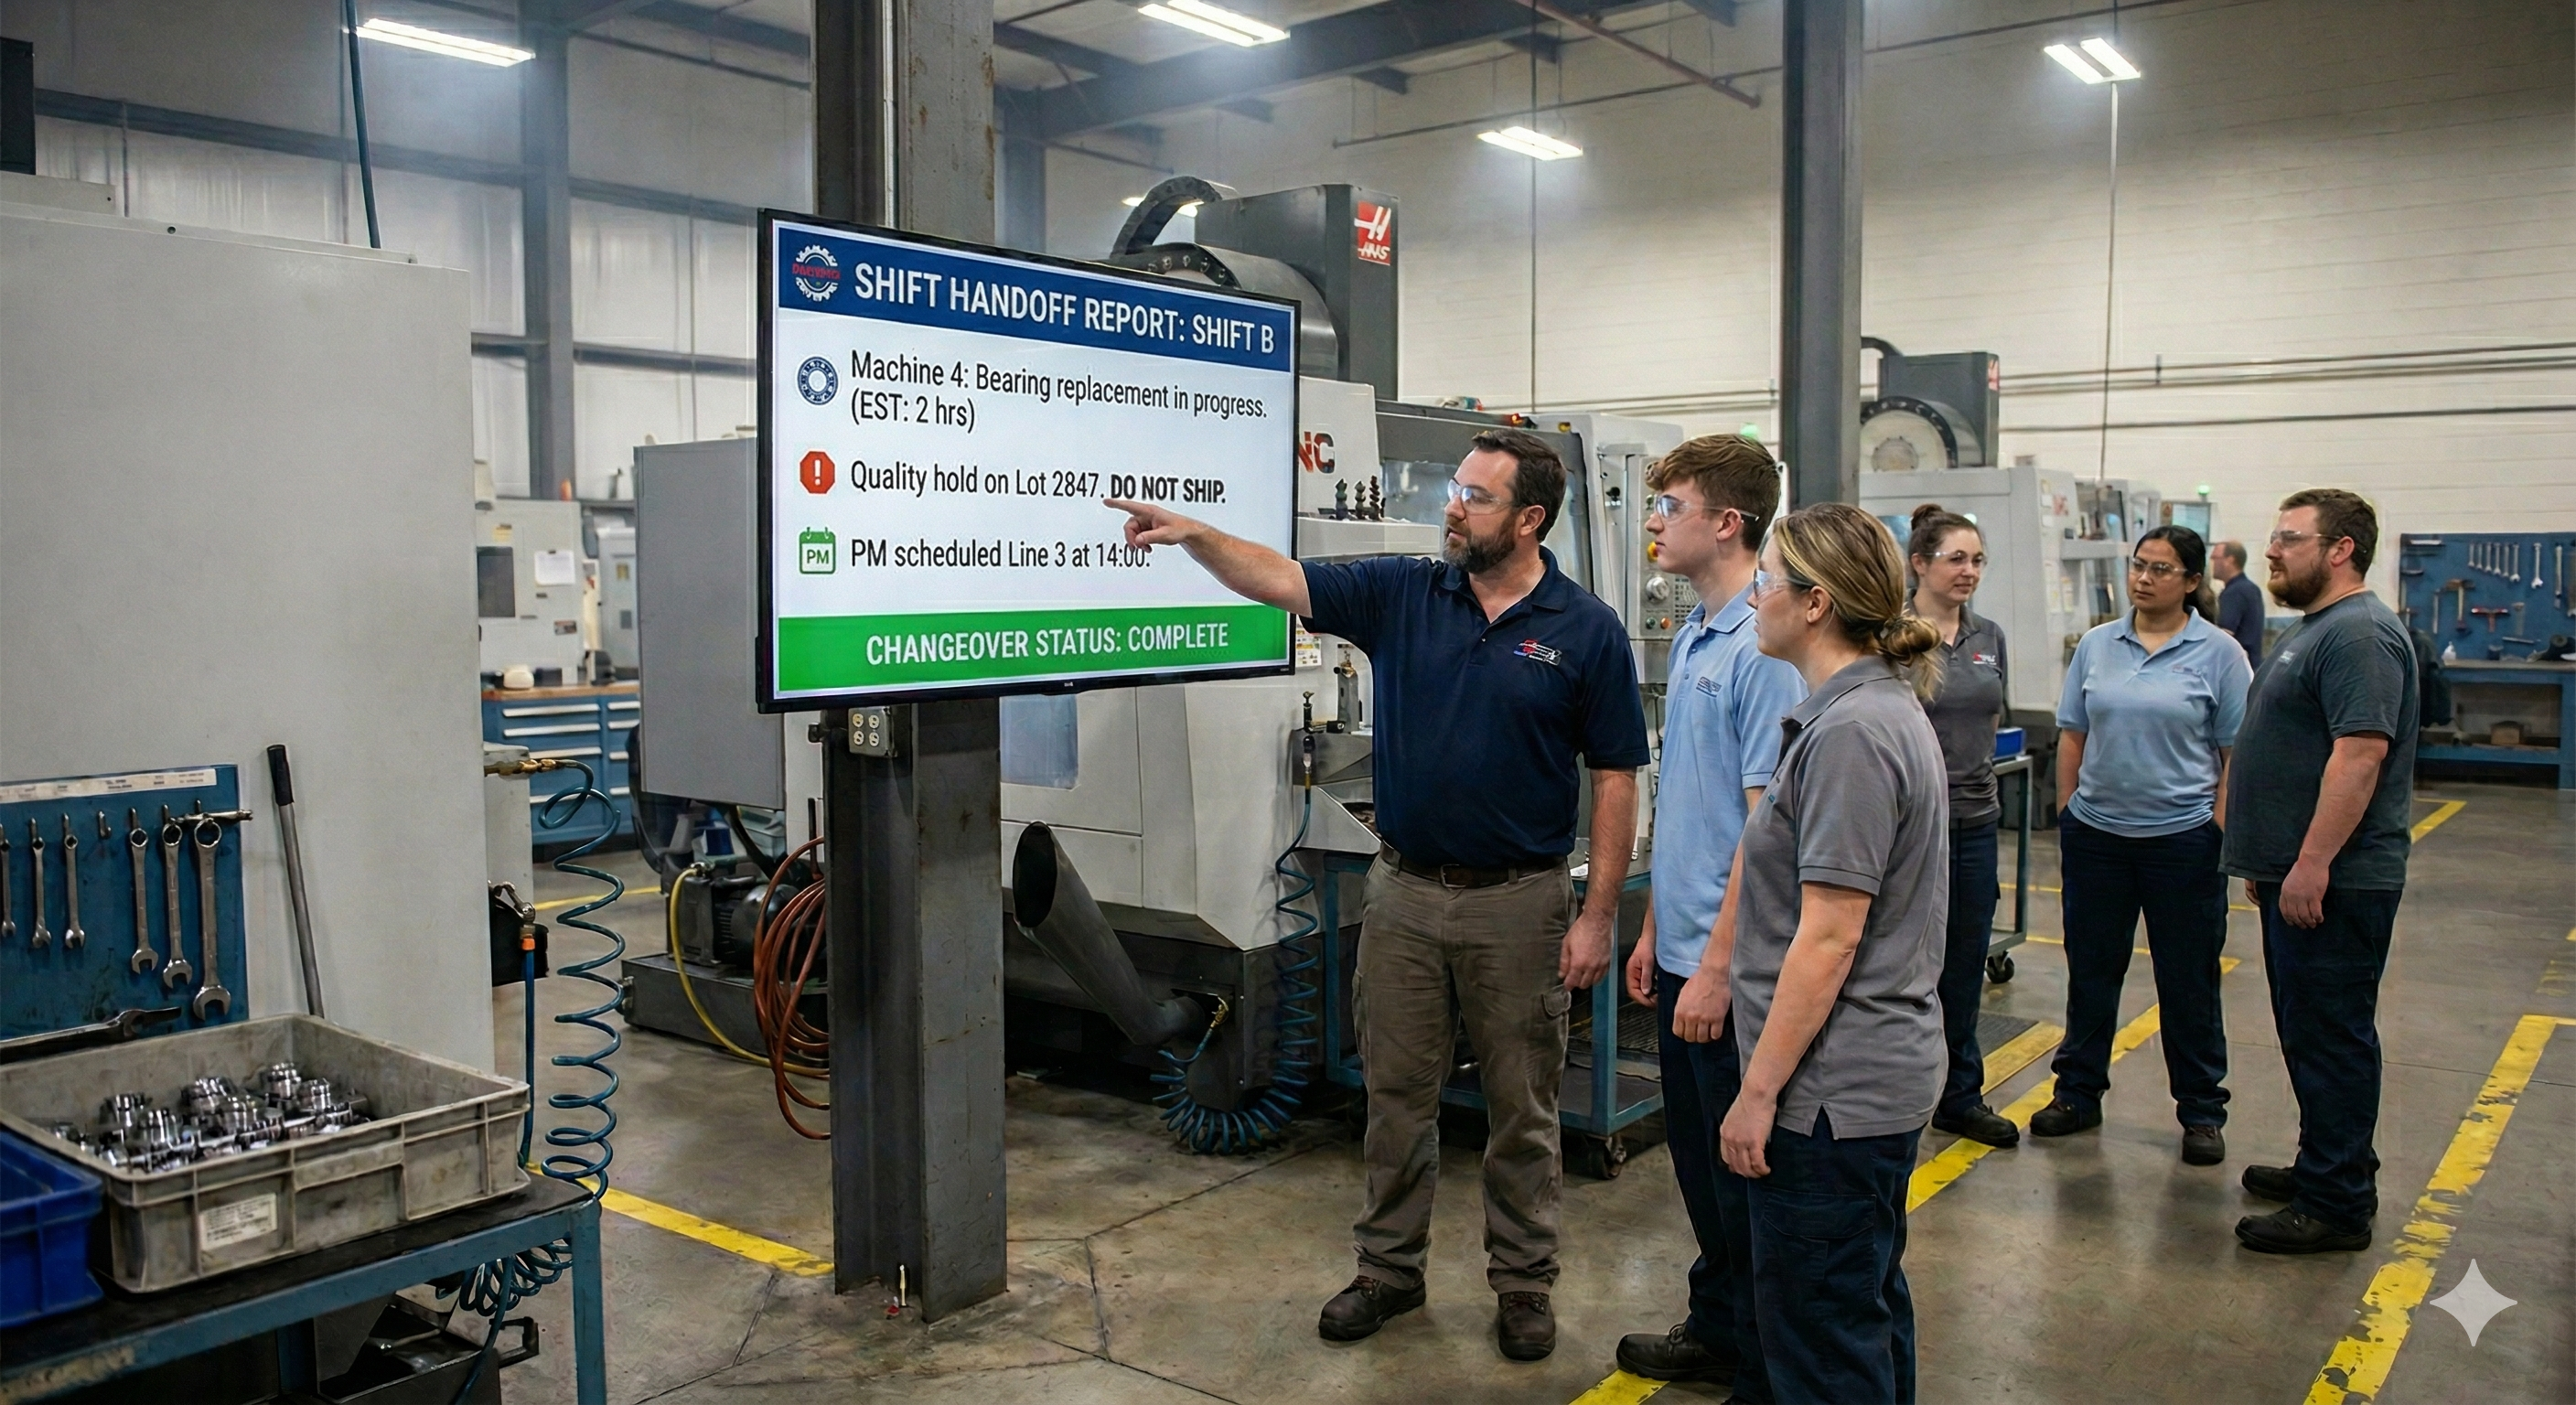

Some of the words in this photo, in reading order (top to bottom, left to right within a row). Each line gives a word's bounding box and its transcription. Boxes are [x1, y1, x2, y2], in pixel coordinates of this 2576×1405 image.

[854, 263, 942, 307] SHIFT
[950, 276, 1077, 327] HANDOFF
[1085, 297, 1186, 342] REPORT:
[1192, 314, 1255, 351] SHIFT
[1261, 325, 1274, 353] B
[852, 349, 944, 386] Machine
[950, 360, 969, 389] 4:
[976, 363, 1051, 403] Bearing
[1057, 374, 1169, 409] replacement
[1174, 384, 1188, 410] in
[1194, 392, 1267, 421] progress.
[851, 389, 908, 425] (EST:
[916, 395, 928, 424] 2
[936, 395, 975, 434] hrs)
[851, 460, 928, 499] Quality
[934, 463, 978, 493] hold
[984, 473, 1009, 495] on
[1016, 468, 1046, 497] Lot
[1052, 470, 1104, 499] 2847.
[1110, 473, 1137, 499] DO
[1142, 476, 1179, 501] NOT
[1182, 477, 1226, 504] SHIP.
[807, 549, 829, 564] PM
[852, 539, 886, 567] PM
[894, 538, 1002, 567] scheduled
[1008, 541, 1049, 567] Line
[1054, 541, 1066, 568] 3
[1071, 543, 1090, 568] at
[866, 632, 1029, 666] CHANGEOVER
[1036, 627, 1122, 657] STATUS:
[1128, 622, 1229, 652] COMPLETE
